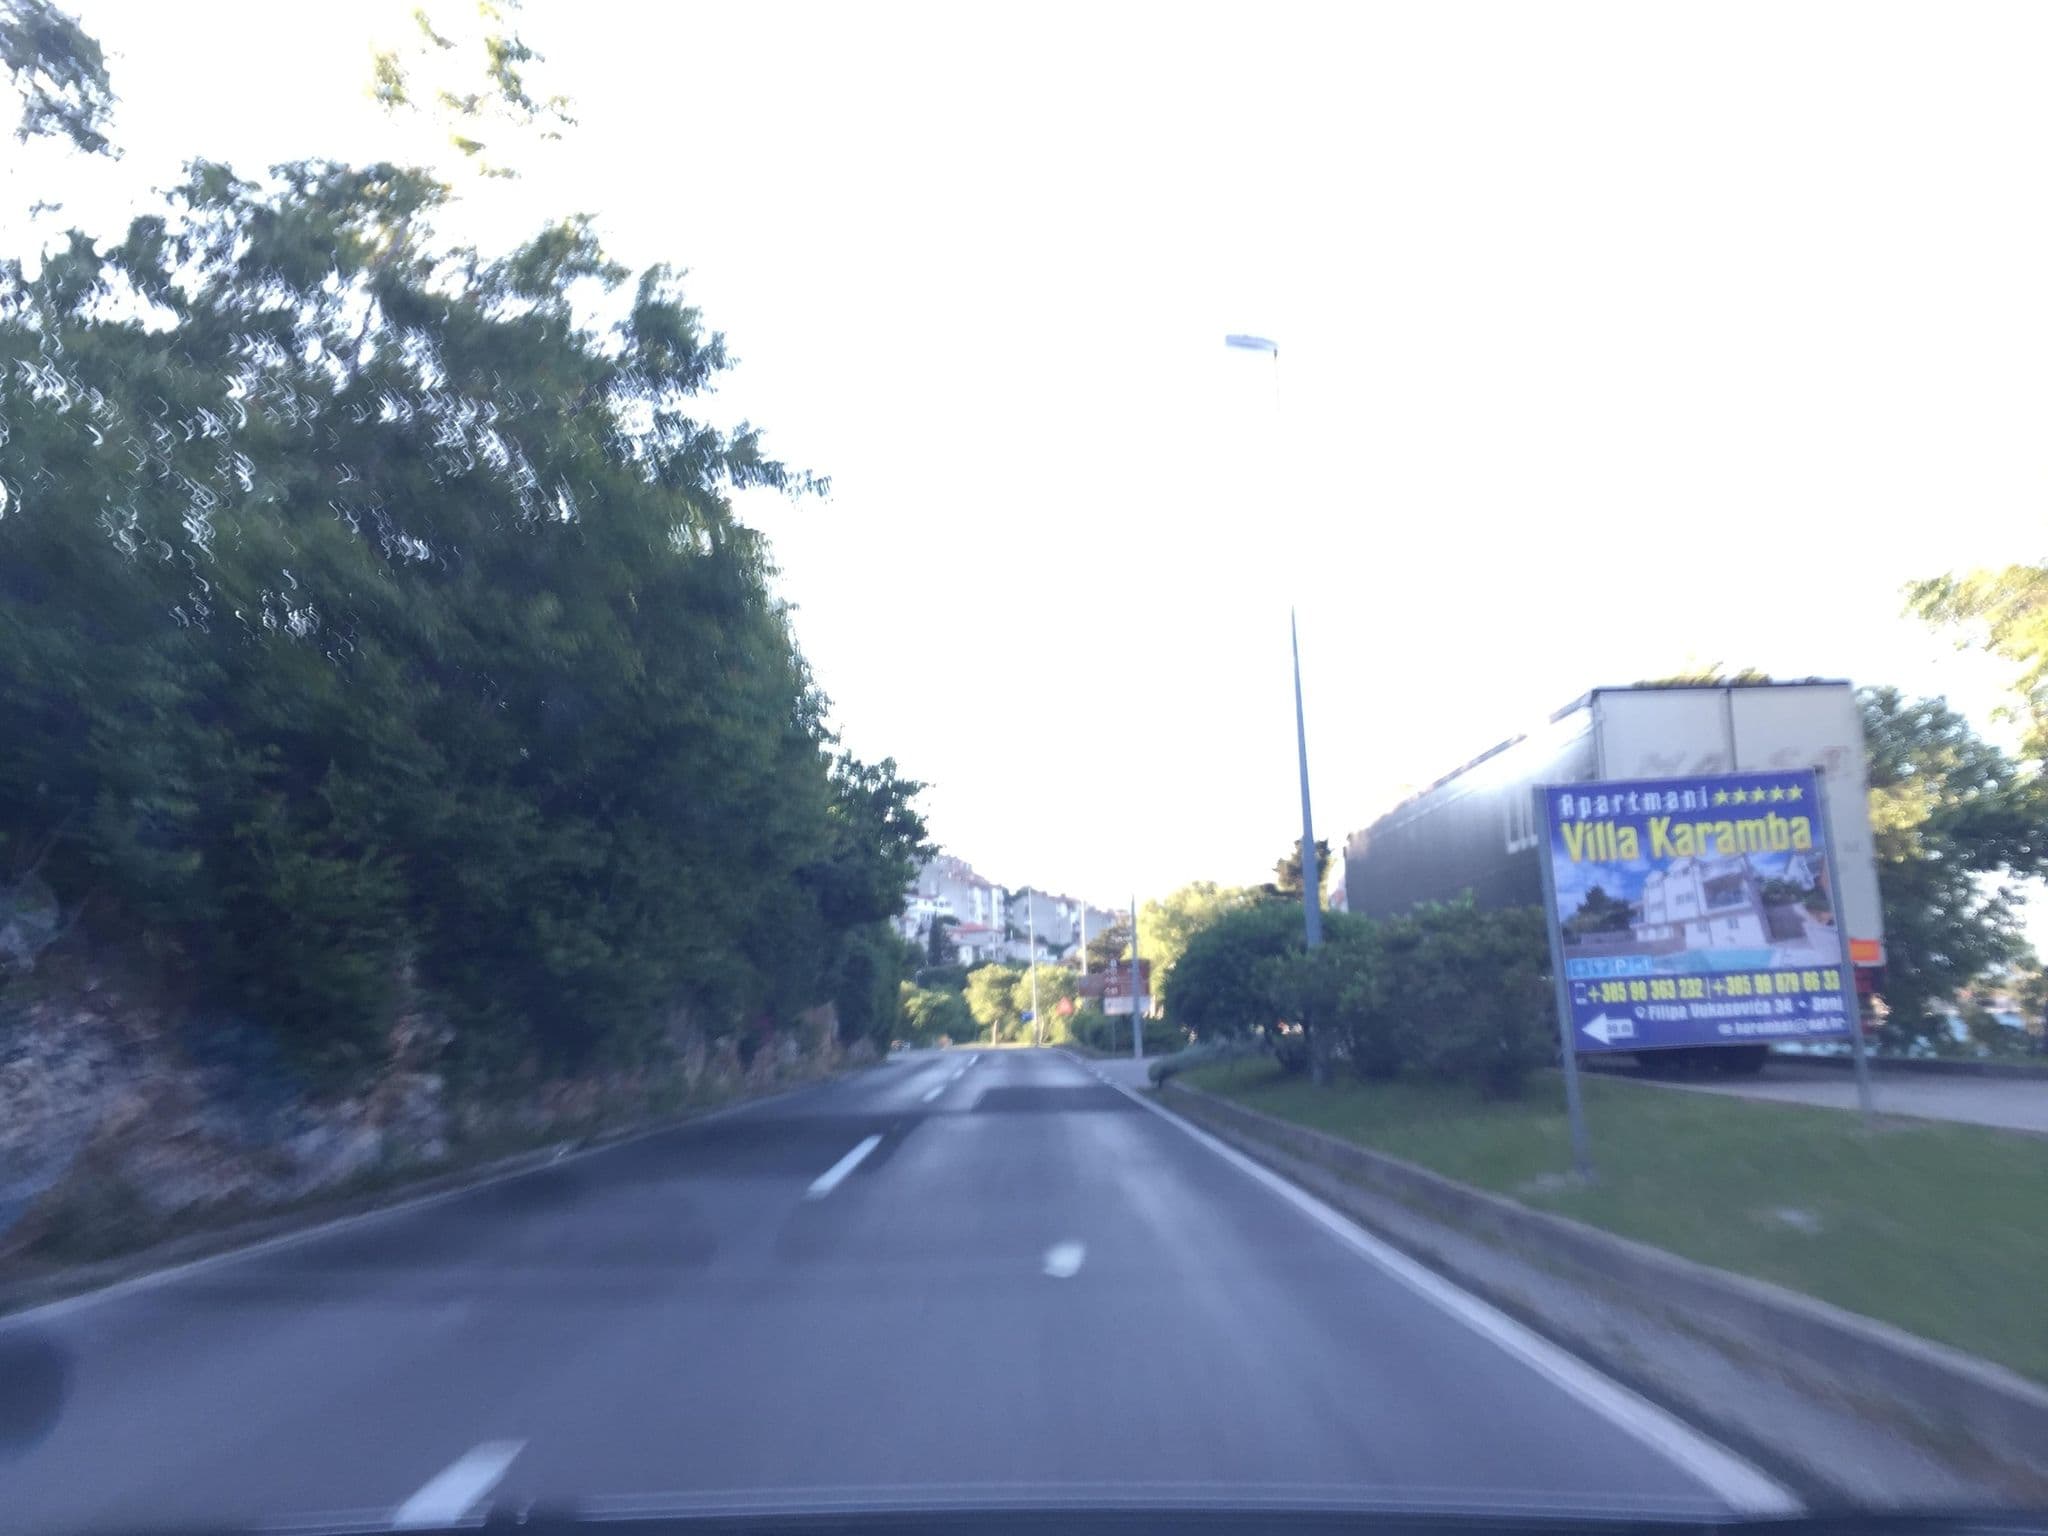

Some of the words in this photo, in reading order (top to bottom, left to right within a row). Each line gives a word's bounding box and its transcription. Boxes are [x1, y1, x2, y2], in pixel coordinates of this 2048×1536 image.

[1560, 786, 1708, 818] Apartmani
[1561, 819, 1640, 863] Villa
[1649, 810, 1813, 858] Karamba
